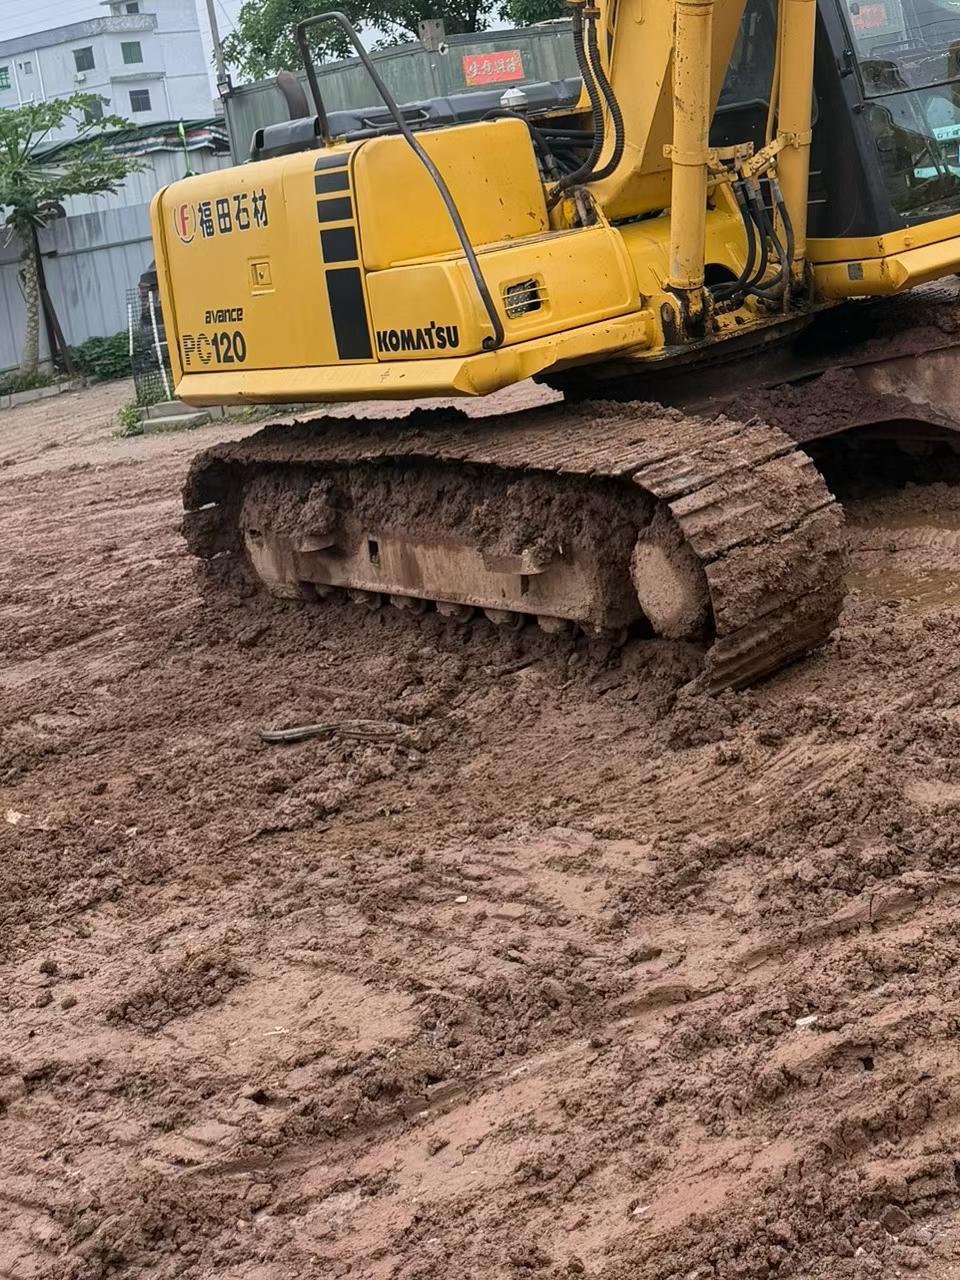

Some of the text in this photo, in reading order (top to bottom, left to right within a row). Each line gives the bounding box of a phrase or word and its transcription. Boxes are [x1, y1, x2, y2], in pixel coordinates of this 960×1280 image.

[198, 188, 268, 238] 福田石材
[205, 308, 243, 324] avance
[182, 330, 247, 366] PC120
[376, 321, 460, 352] KOMATSU
